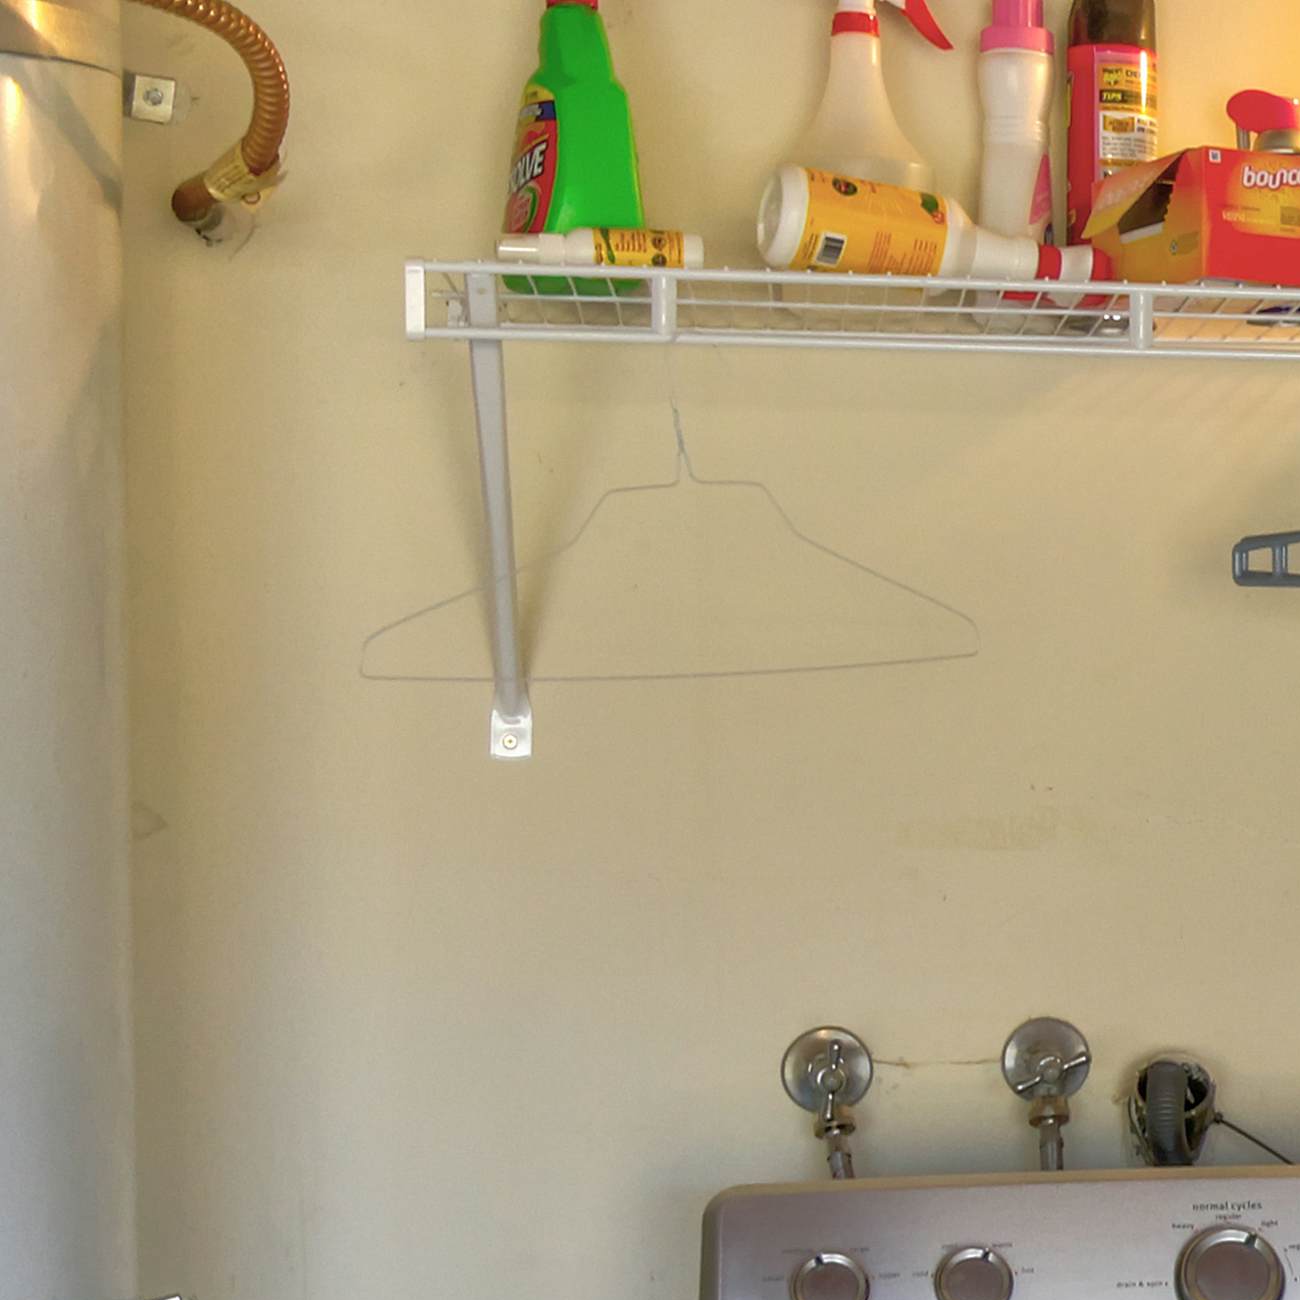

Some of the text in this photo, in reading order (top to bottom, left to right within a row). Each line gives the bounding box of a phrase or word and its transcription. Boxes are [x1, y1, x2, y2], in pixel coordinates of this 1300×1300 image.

[1192, 1200, 1262, 1212] normal cycles
[1216, 1213, 1242, 1221] regular
[1172, 1222, 1194, 1230] heavy
[1261, 1220, 1278, 1228] light
[1116, 1280, 1137, 1288] drain
[1146, 1280, 1163, 1288] spin
